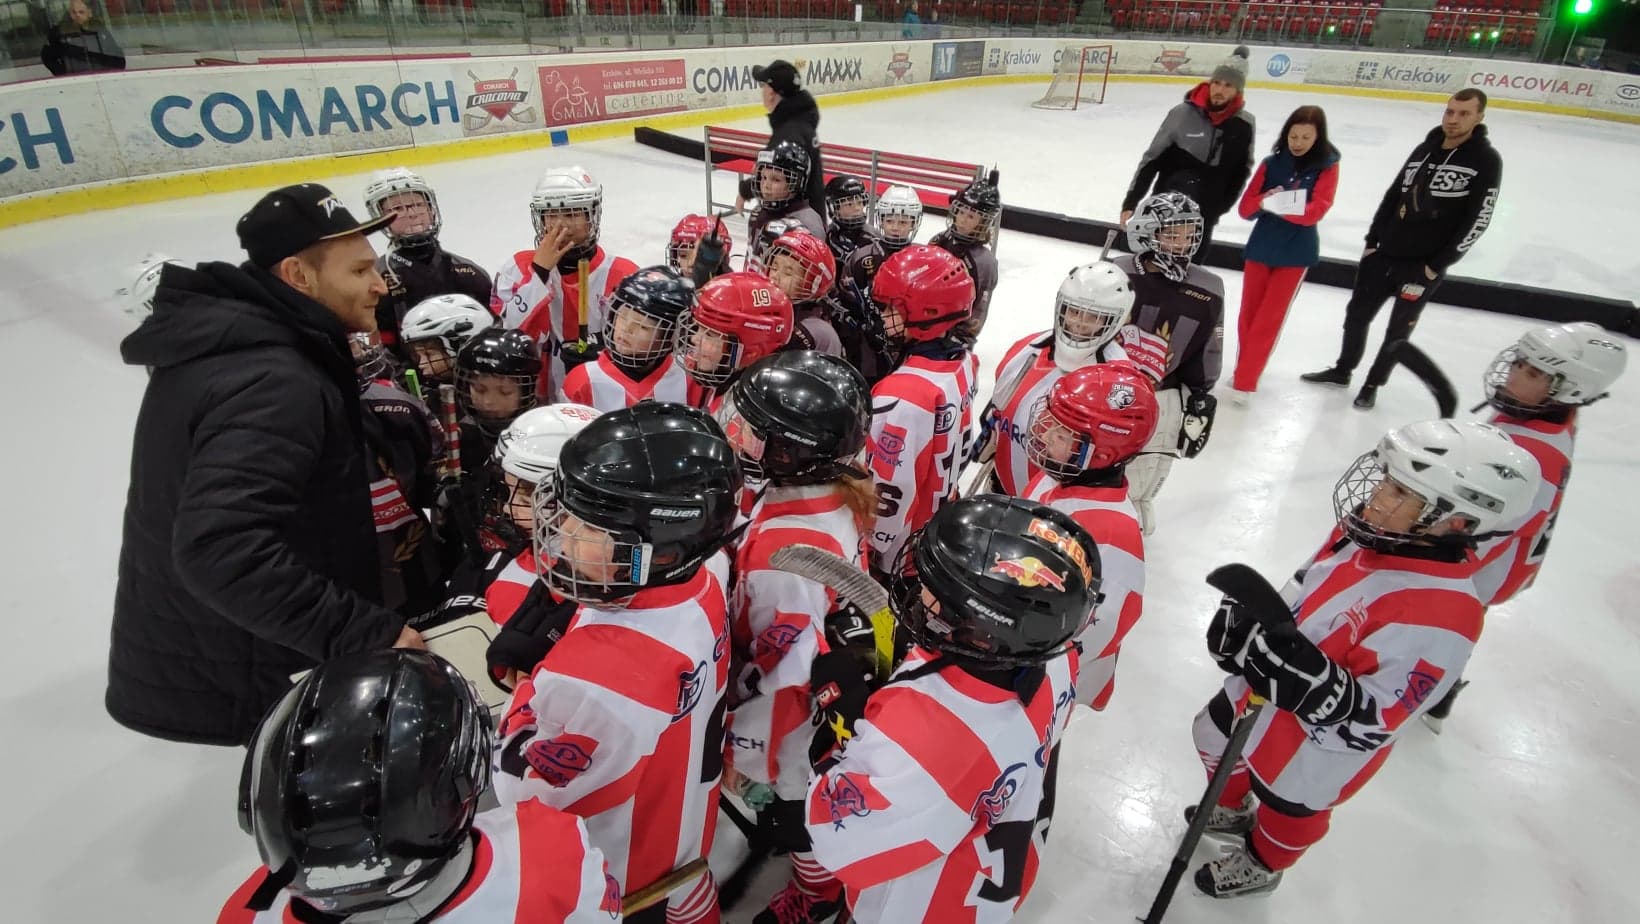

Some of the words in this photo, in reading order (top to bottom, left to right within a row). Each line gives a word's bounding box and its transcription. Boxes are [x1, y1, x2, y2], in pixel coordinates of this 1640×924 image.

[1003, 49, 1041, 65] Kraków
[806, 57, 862, 86] MAXXX
[1382, 66, 1452, 85] Kraków
[1470, 72, 1593, 98] CRACOVIA.PL
[151, 80, 460, 148] COMARCH
[751, 288, 771, 307] 19
[650, 508, 701, 518] BAUER
[966, 598, 1015, 627] BAUER
